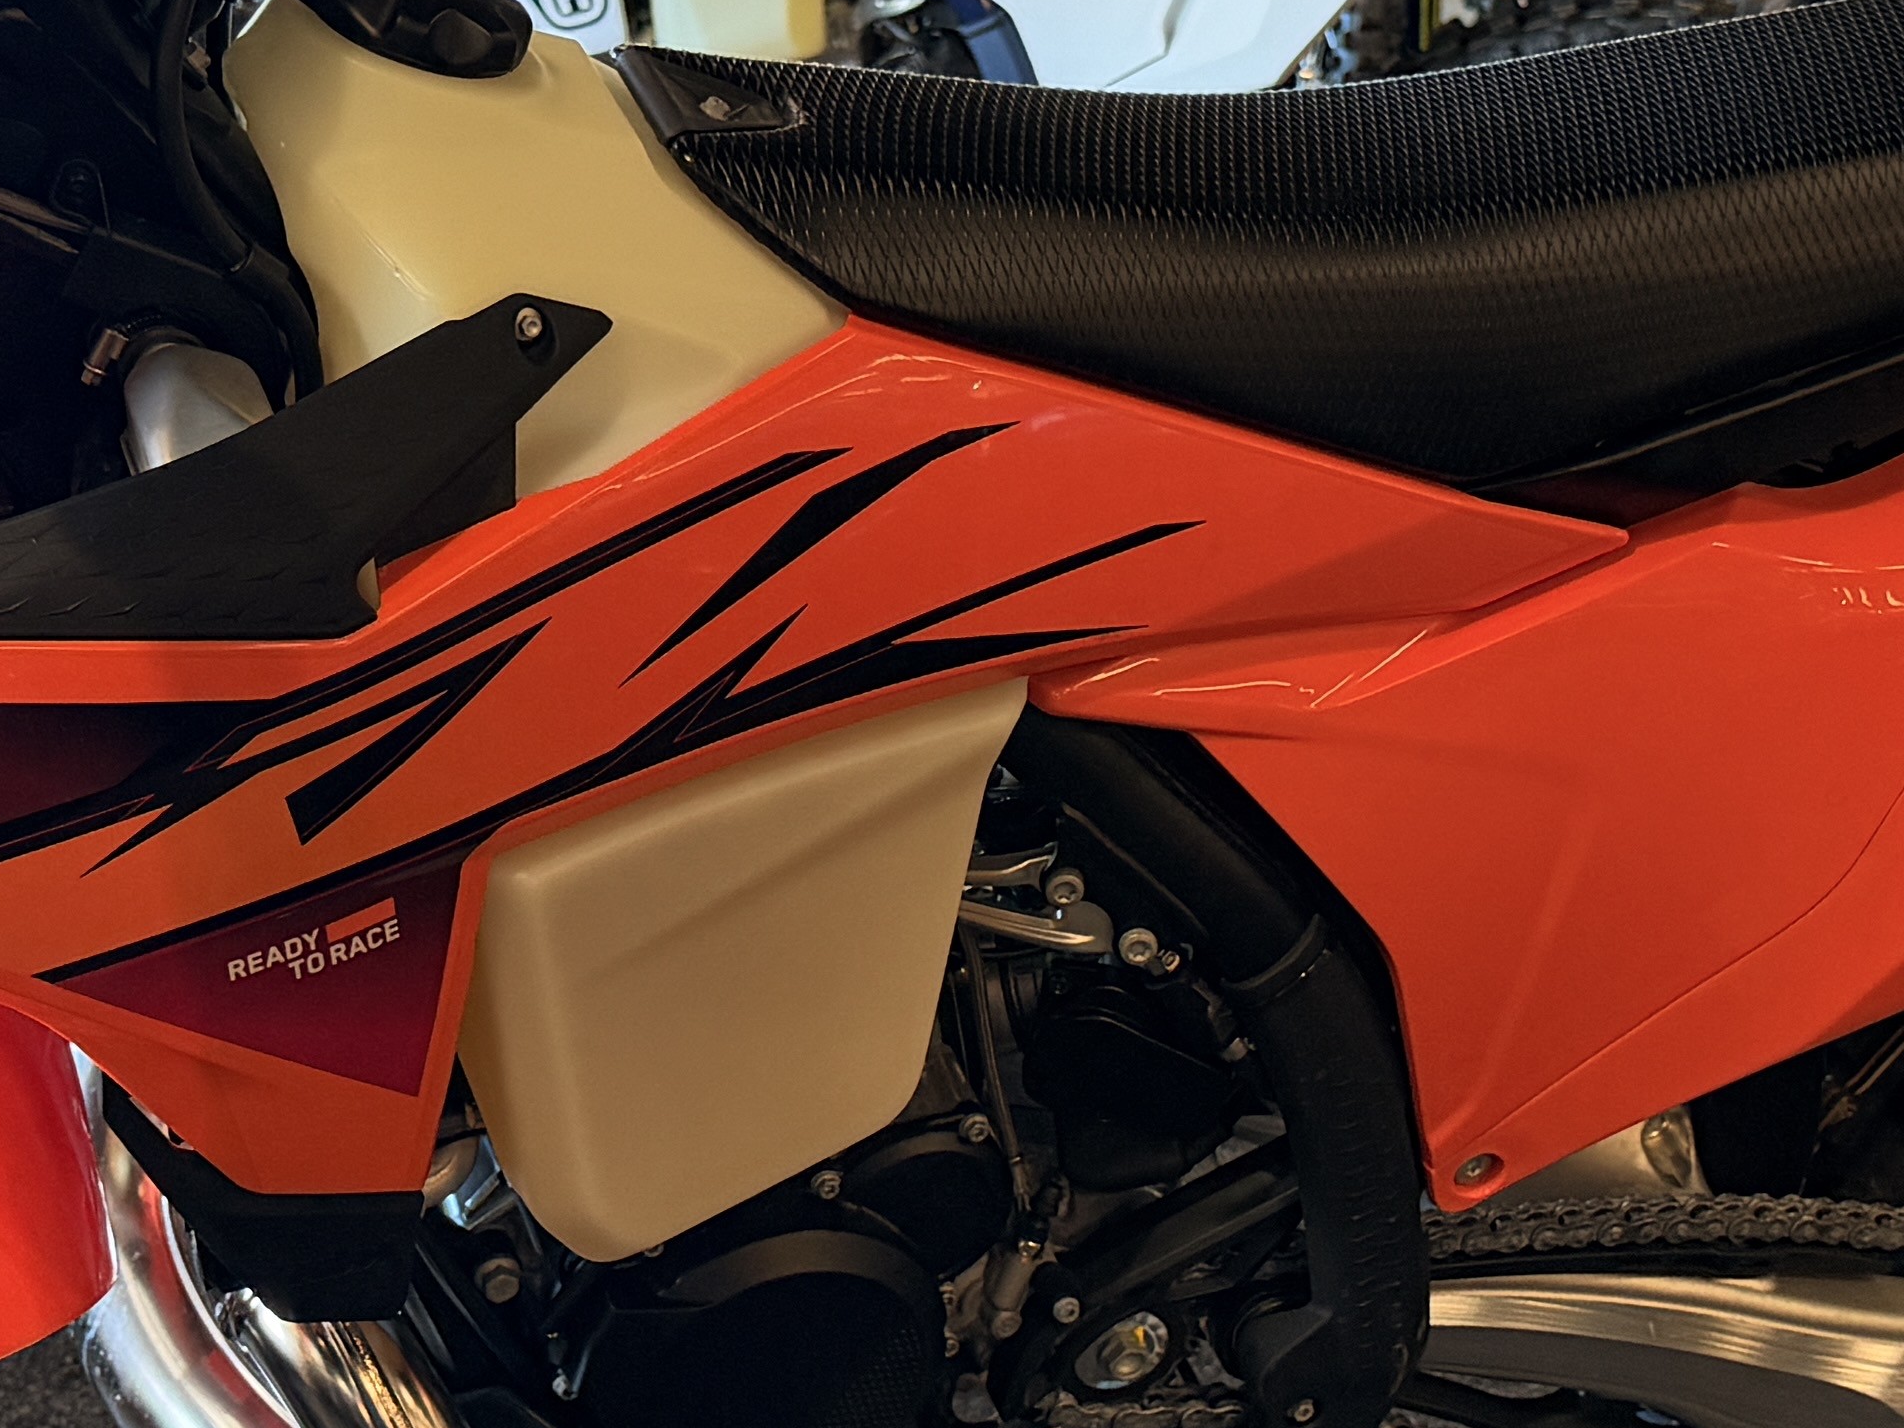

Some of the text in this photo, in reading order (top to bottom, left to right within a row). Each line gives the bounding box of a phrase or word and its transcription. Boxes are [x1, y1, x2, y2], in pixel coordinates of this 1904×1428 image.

[227, 927, 320, 982] READY
[288, 918, 400, 980] TO RACE
